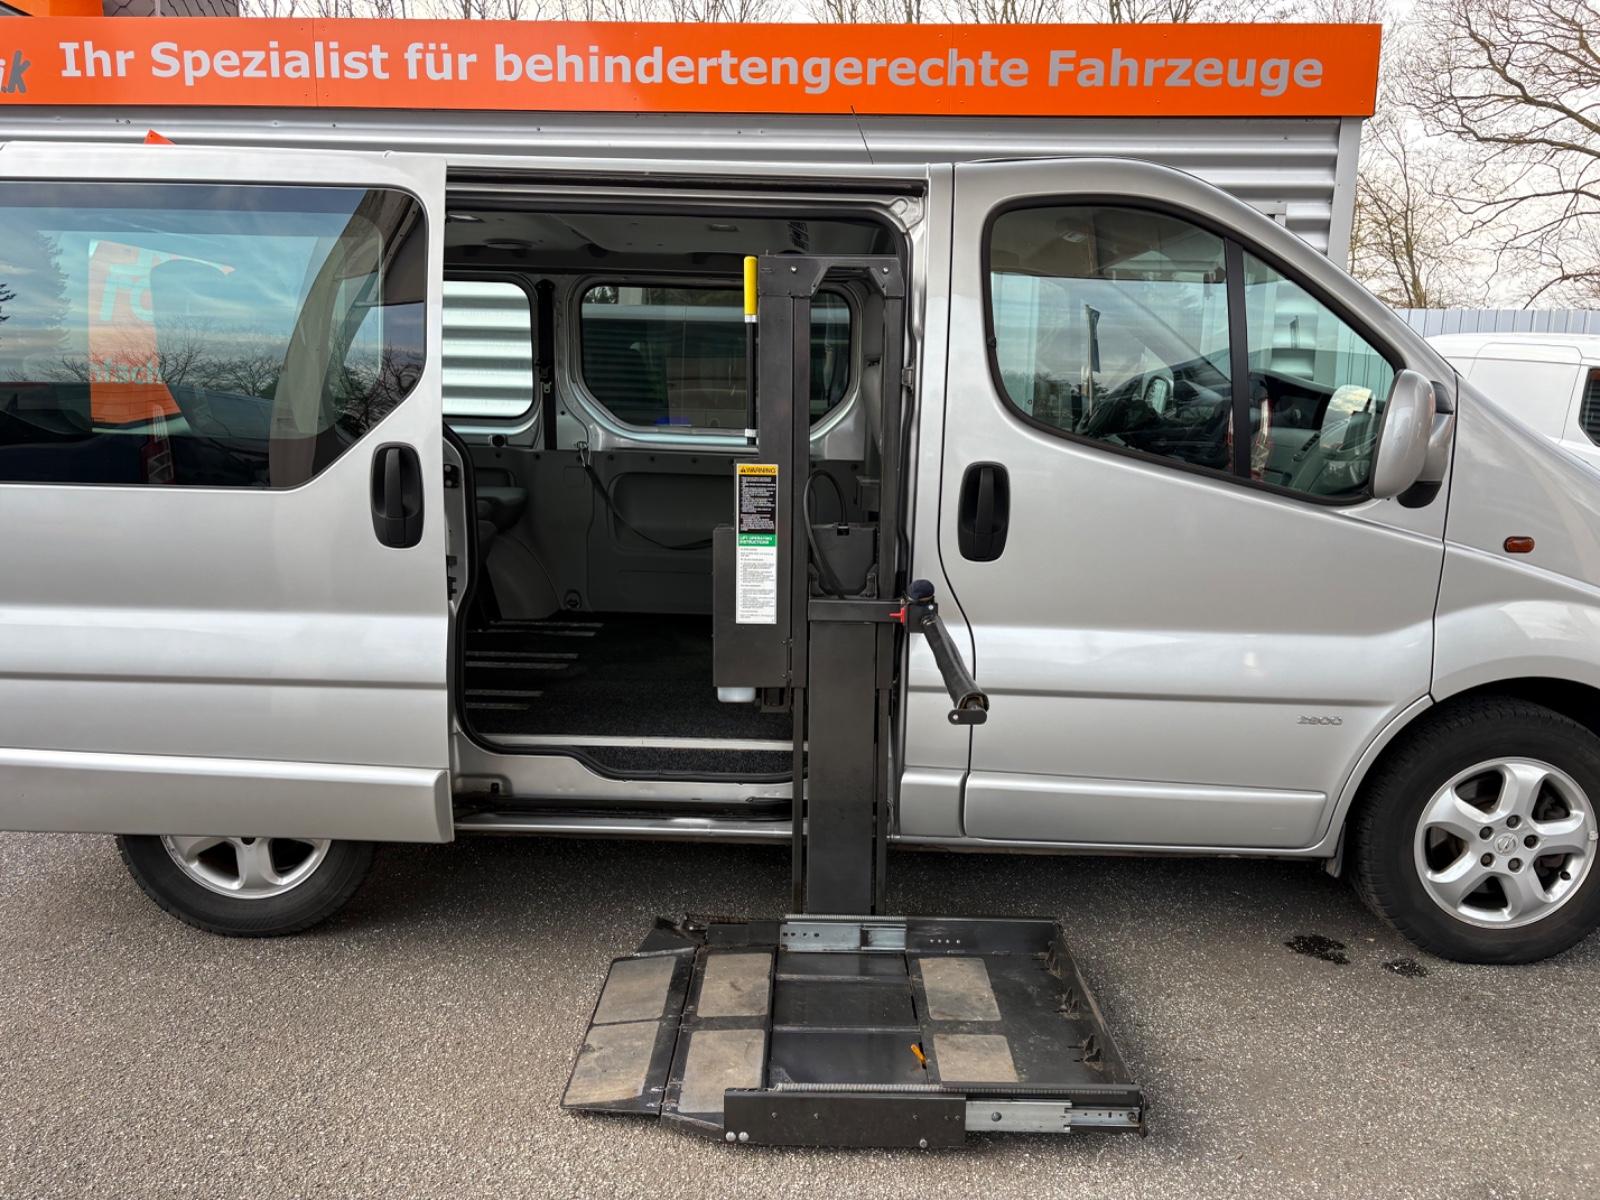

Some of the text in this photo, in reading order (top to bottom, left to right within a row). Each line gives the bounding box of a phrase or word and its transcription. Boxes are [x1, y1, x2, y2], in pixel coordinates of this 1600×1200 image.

[58, 39, 1323, 97] Ihr Spezialist für behindertengerechte Fahrzeuge
[747, 466, 776, 474] WARNING
